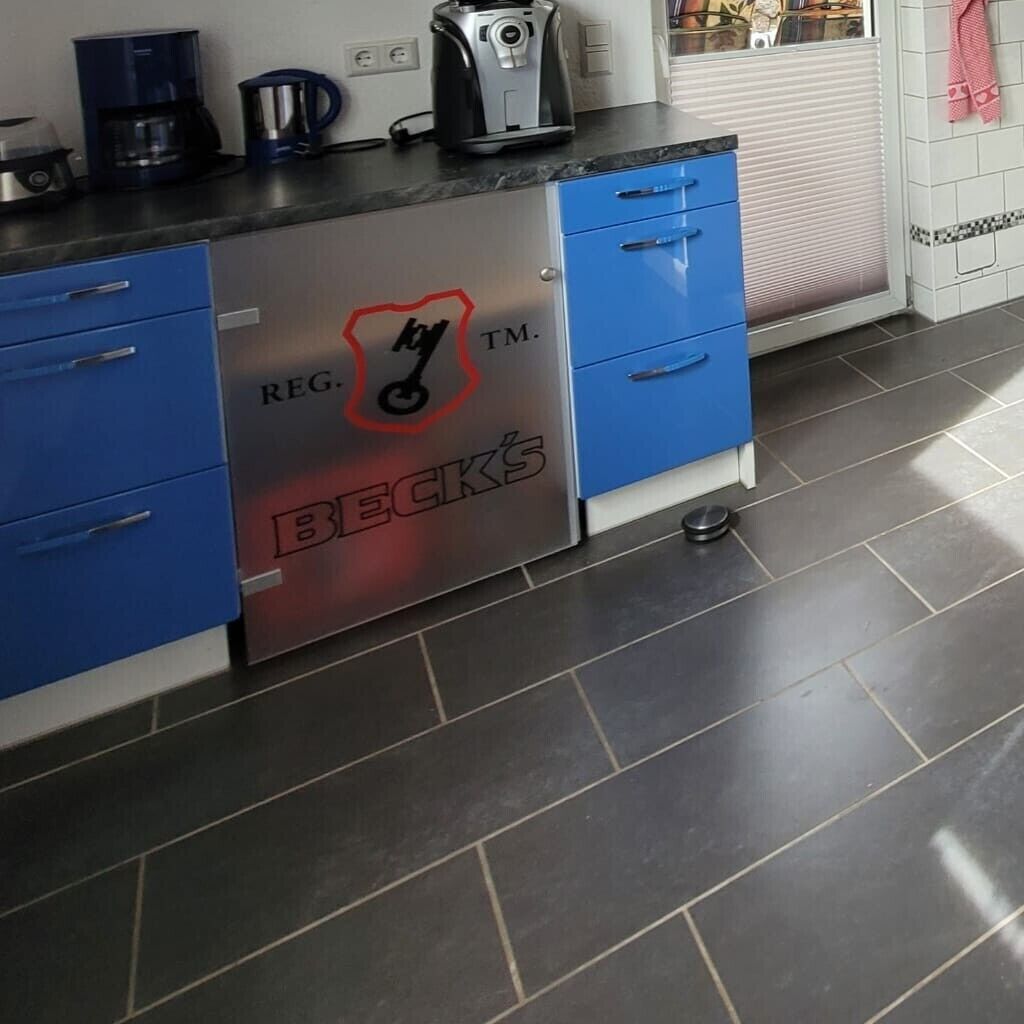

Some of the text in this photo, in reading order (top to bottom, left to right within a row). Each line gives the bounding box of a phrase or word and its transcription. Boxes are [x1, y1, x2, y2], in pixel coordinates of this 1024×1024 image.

[261, 323, 539, 406] REG. TM.
[272, 430, 547, 559] BECK'S
